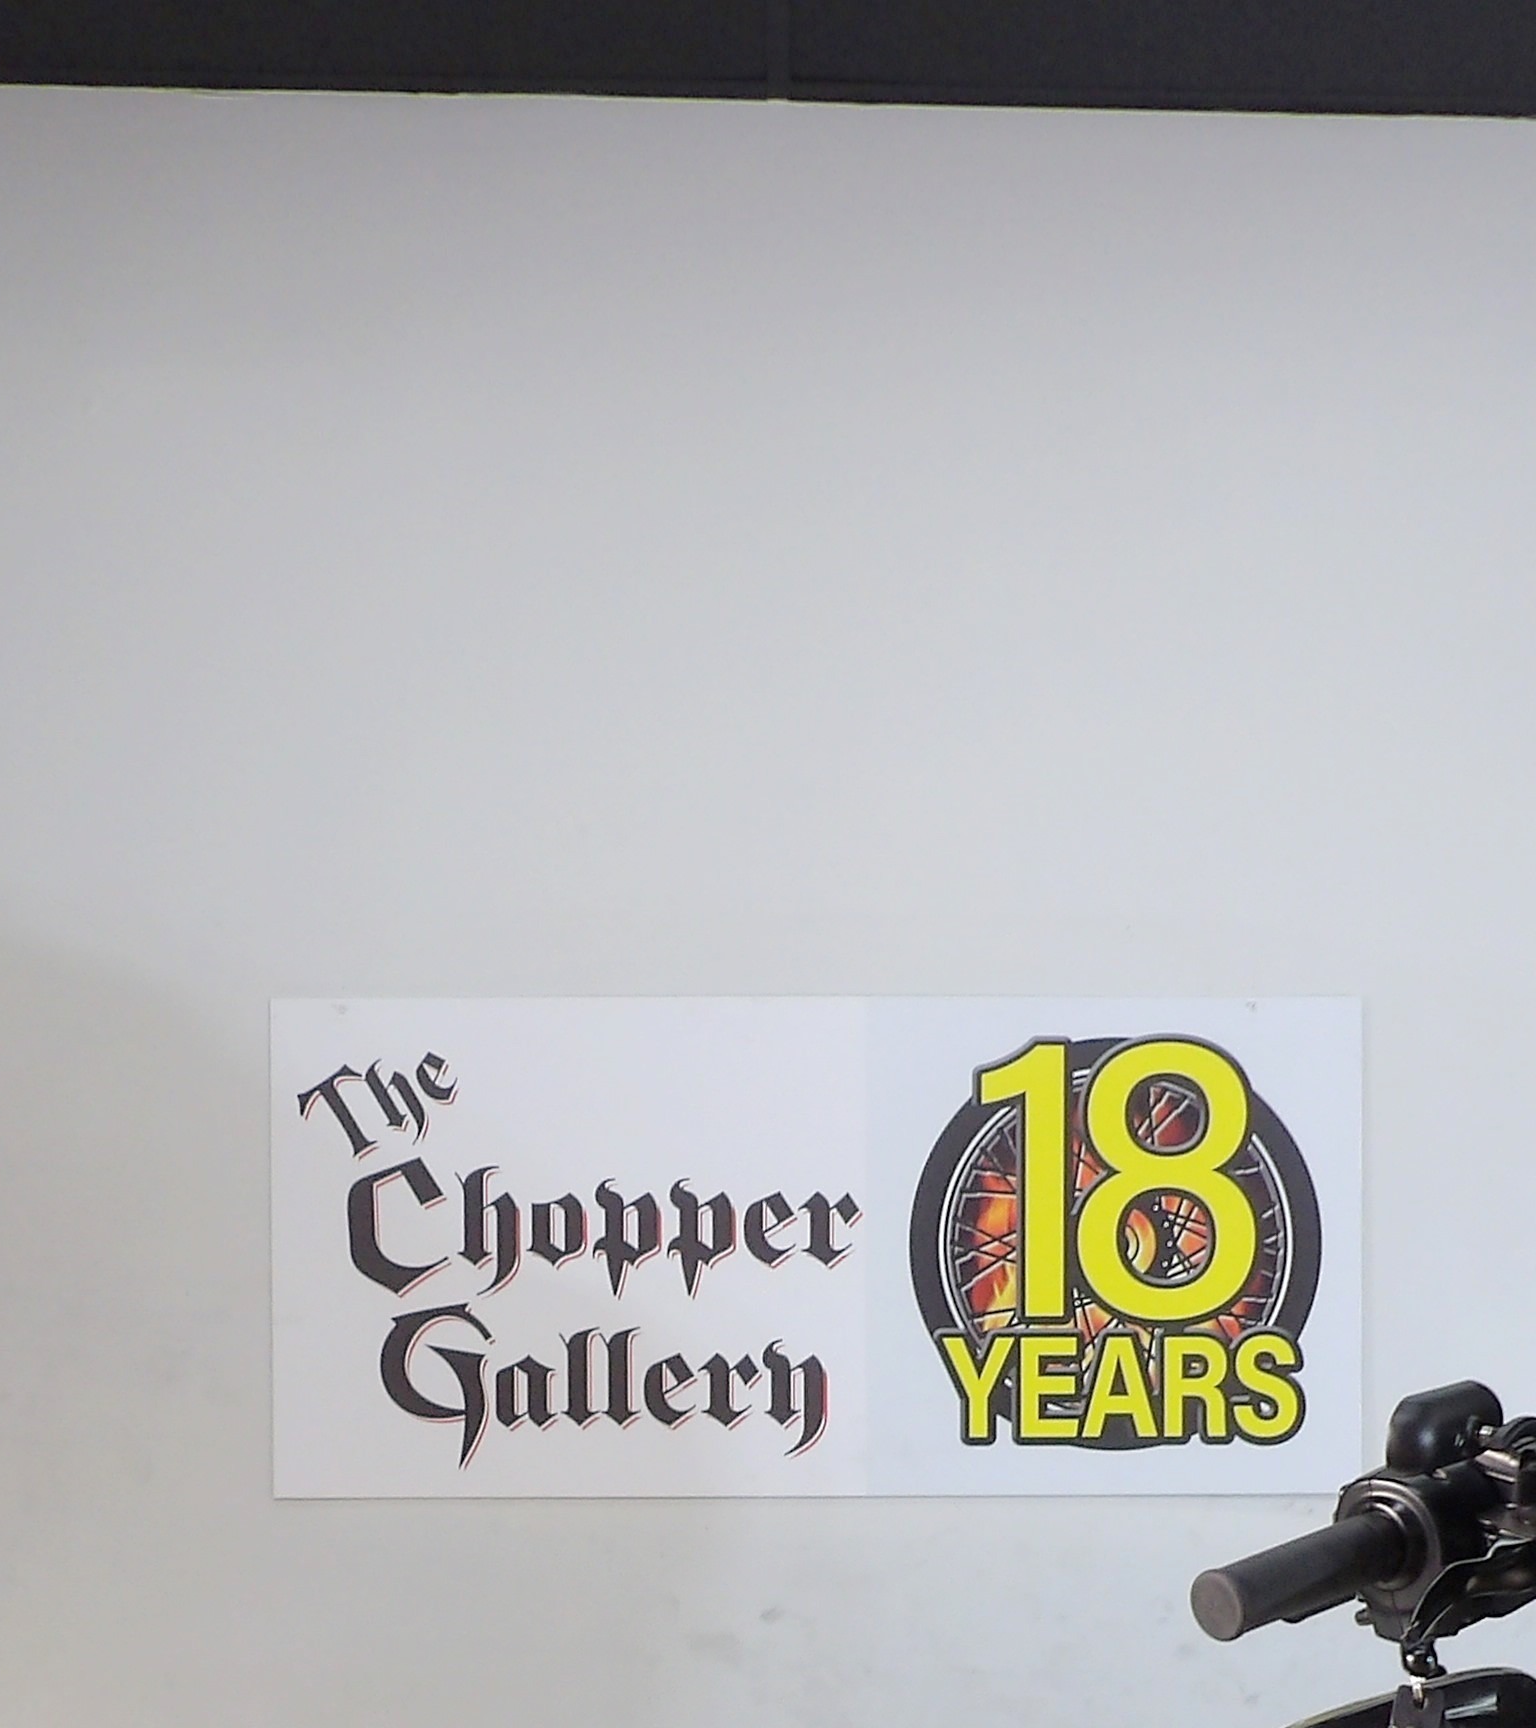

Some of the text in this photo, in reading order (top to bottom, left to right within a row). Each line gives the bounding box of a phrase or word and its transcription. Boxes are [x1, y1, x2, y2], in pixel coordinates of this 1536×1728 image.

[297, 1051, 458, 1160] The
[346, 1156, 862, 1300] Chopper
[973, 1035, 1258, 1322] 18
[379, 1302, 830, 1470] Gallery
[934, 1328, 1306, 1446] YEARS
